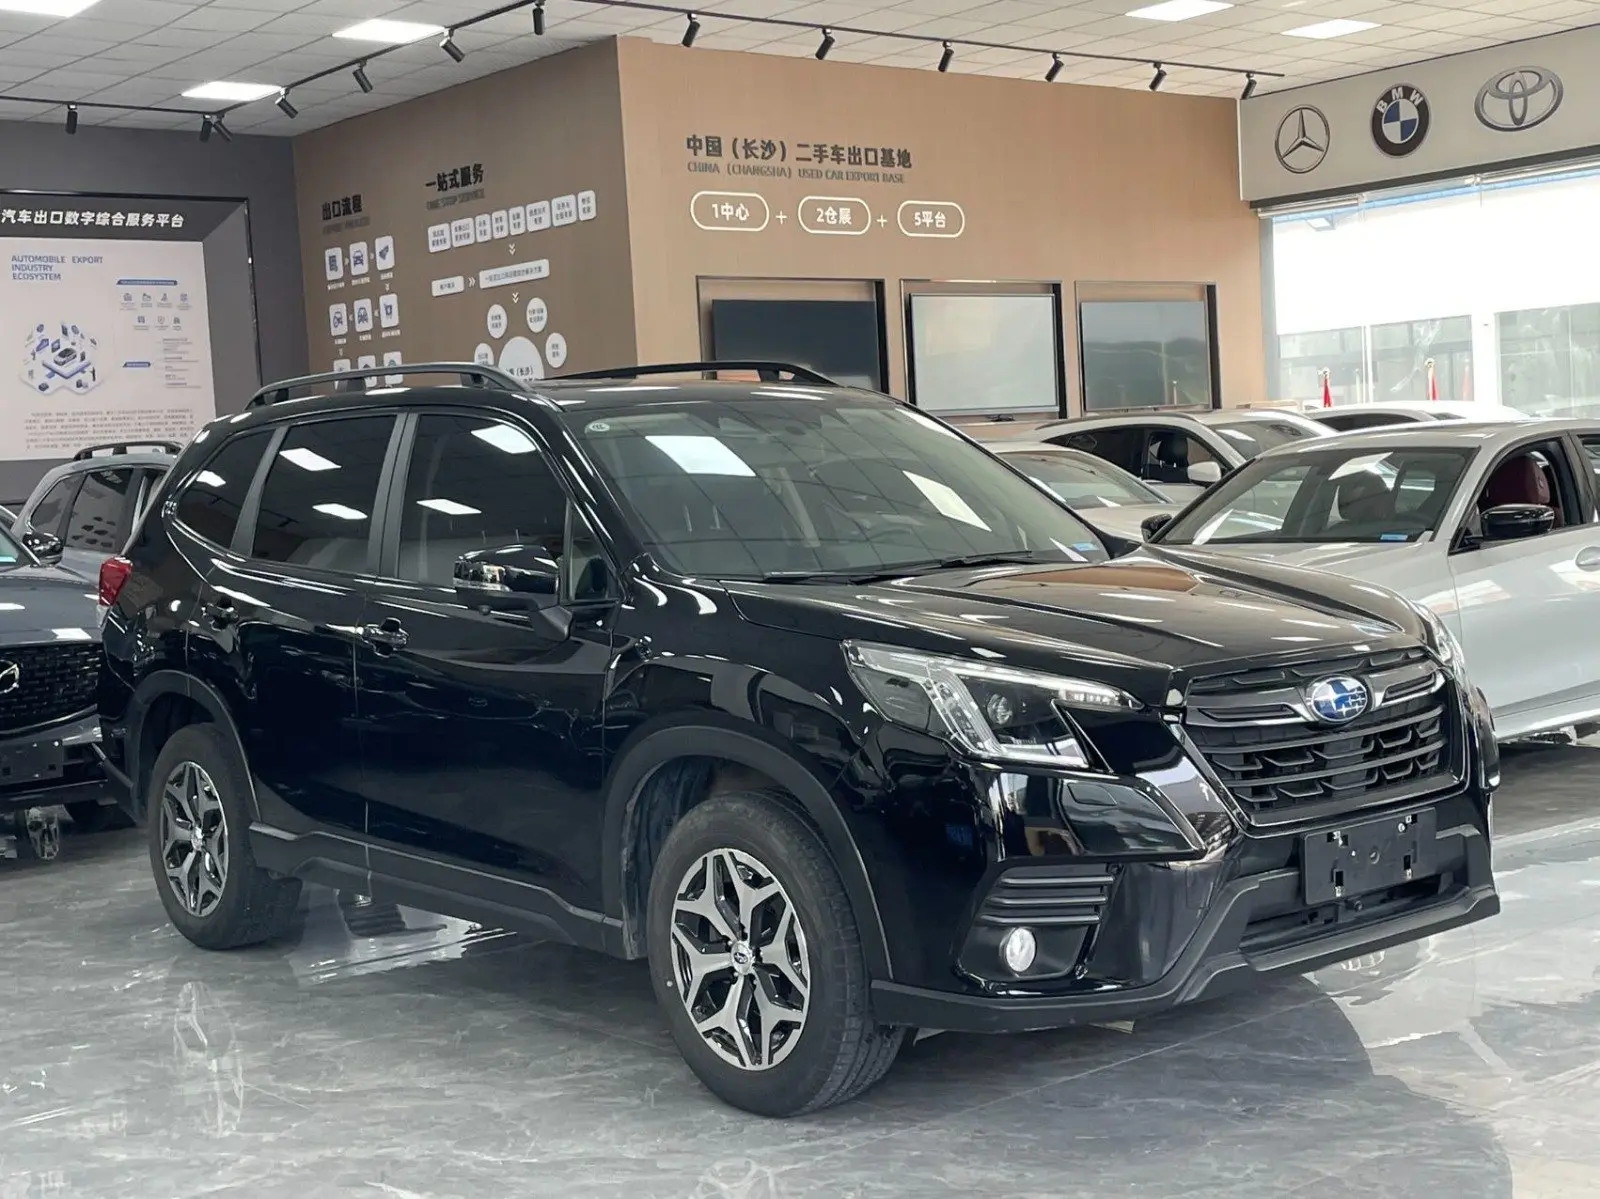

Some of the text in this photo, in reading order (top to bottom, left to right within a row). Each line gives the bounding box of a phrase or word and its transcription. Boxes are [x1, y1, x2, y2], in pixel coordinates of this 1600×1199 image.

[1376, 86, 1424, 114] BMW
[686, 134, 912, 169] 中国（长沙）二手车出口基地
[425, 163, 484, 191] 一站式服务
[687, 161, 720, 174] CHINA
[798, 168, 823, 179] USED
[825, 169, 844, 181] CAR
[845, 170, 880, 183] EXPORT
[882, 172, 904, 184] BASE
[322, 194, 363, 220] 出口流程
[711, 202, 750, 222] 1中心
[816, 206, 852, 225] 2仓展
[1, 209, 184, 228] 汽车出口数字综合服务平台
[914, 210, 947, 229] 5平台
[11, 255, 103, 264] AUTOMOBILE EXPORT
[12, 264, 53, 272] INDUSTRY
[12, 273, 61, 281] ECOSYSTEM
